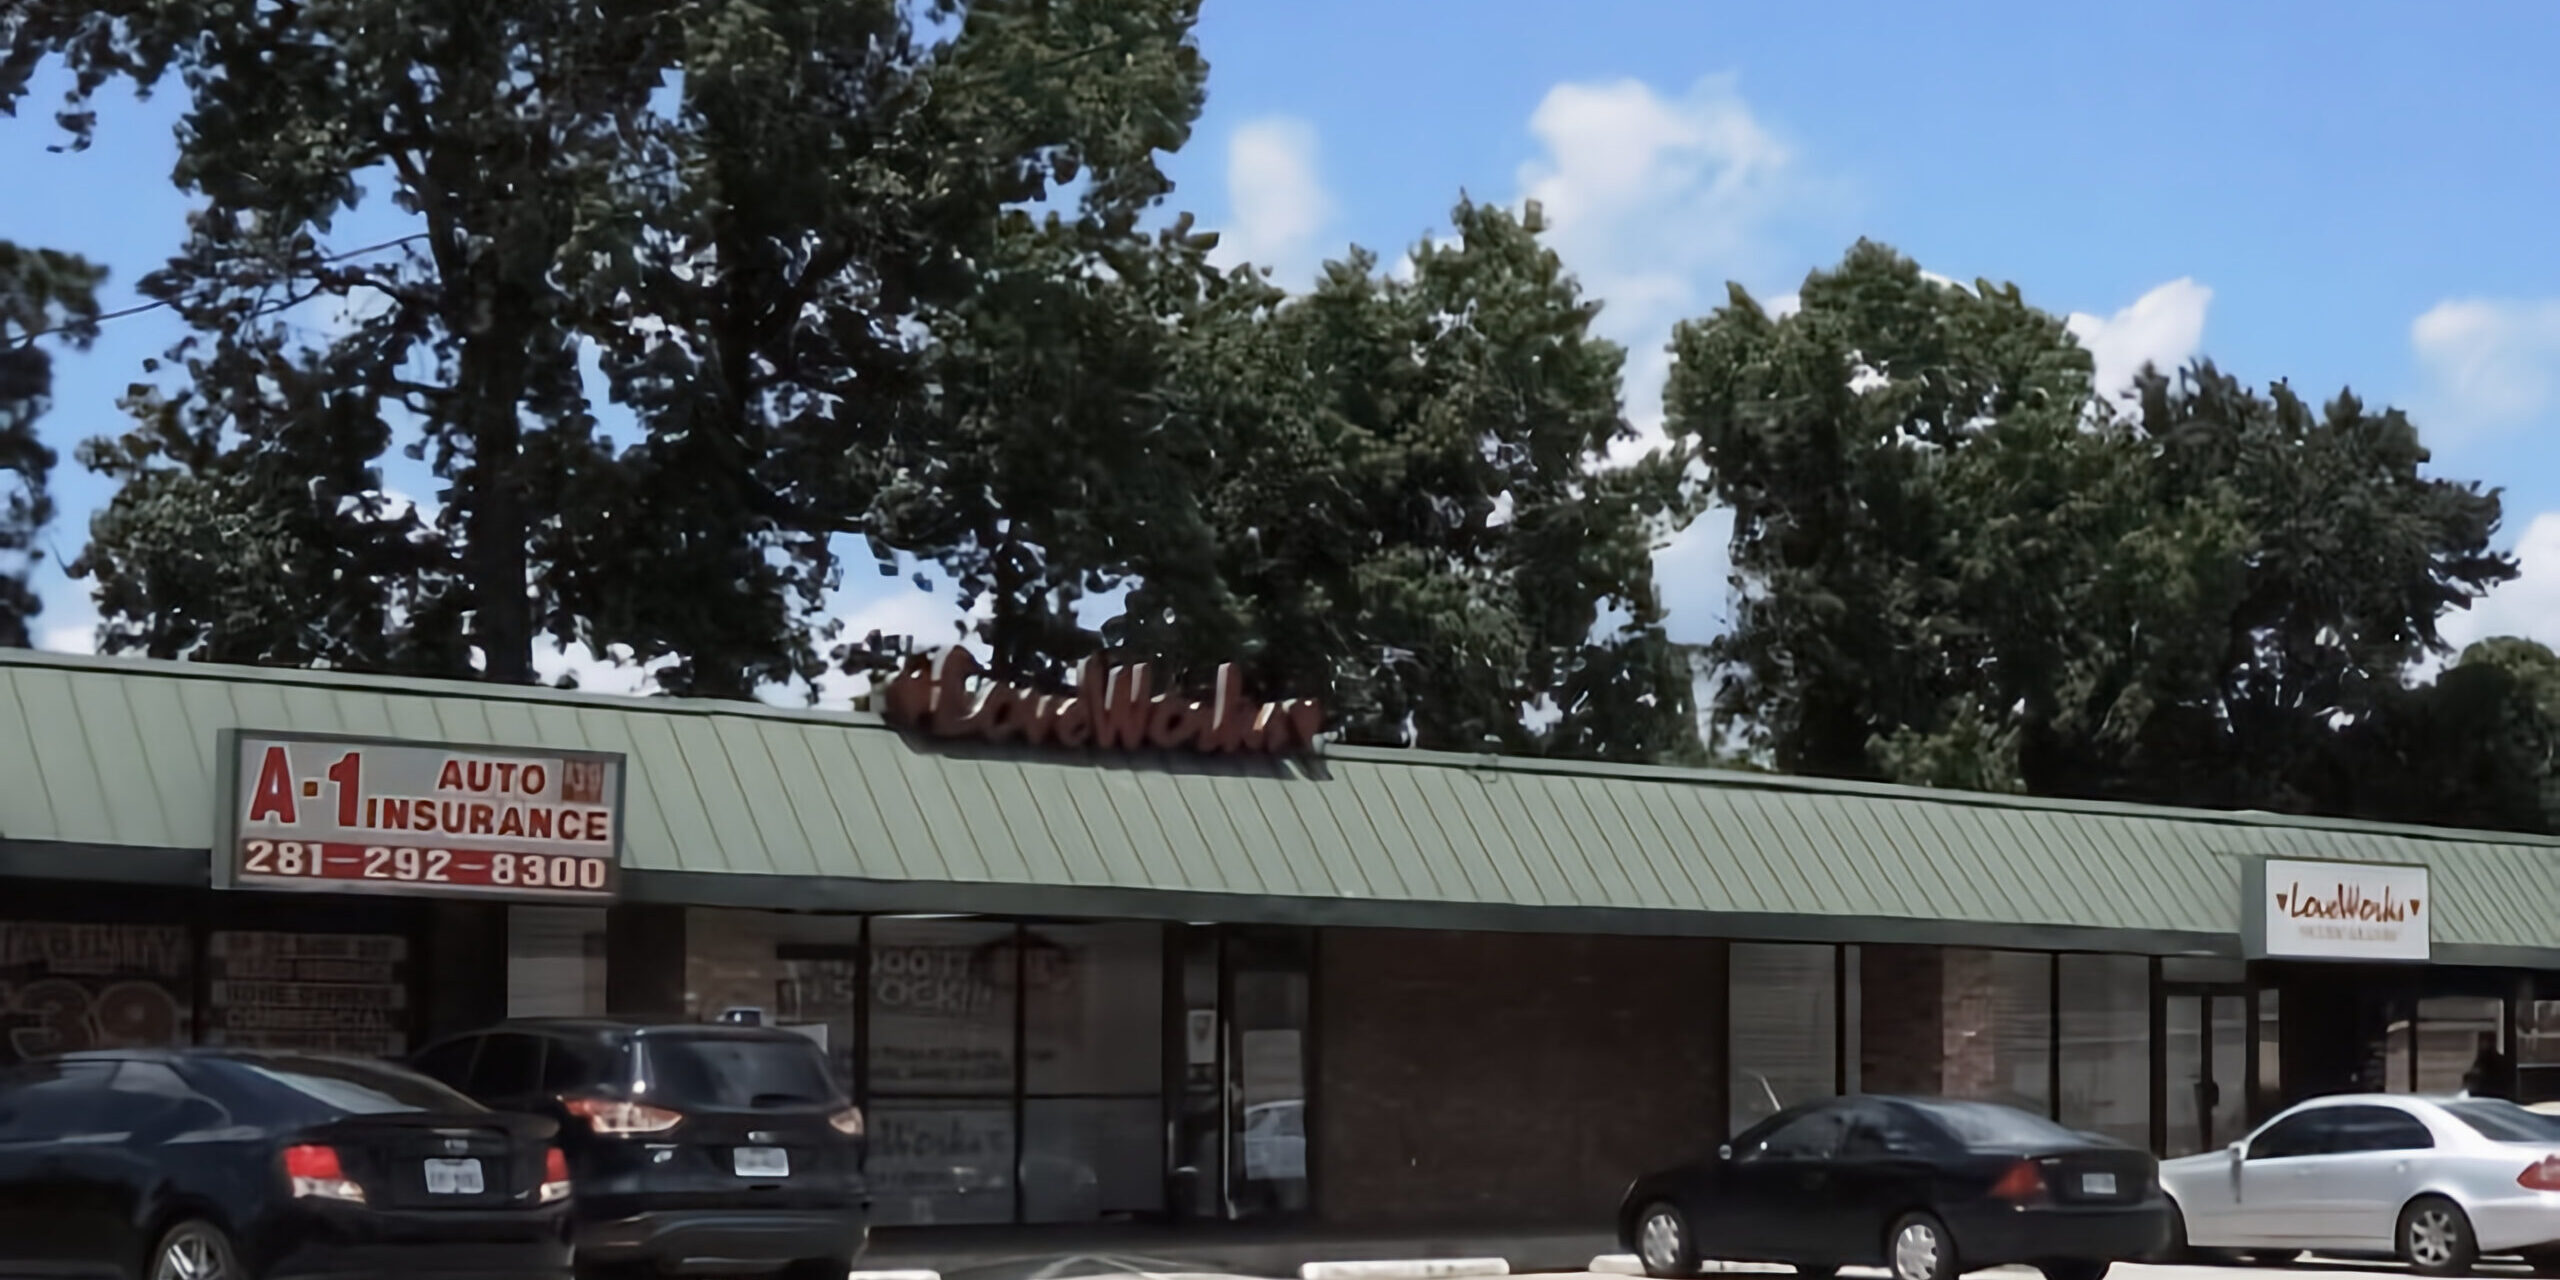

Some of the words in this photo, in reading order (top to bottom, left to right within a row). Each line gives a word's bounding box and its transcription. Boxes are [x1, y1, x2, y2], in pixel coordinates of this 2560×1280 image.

[249, 745, 362, 826] A-1
[438, 759, 547, 795] AUTO
[366, 797, 609, 842] INSURANCE
[245, 840, 606, 889] 281-292-8300
[2291, 881, 2404, 923] LoveWorks
